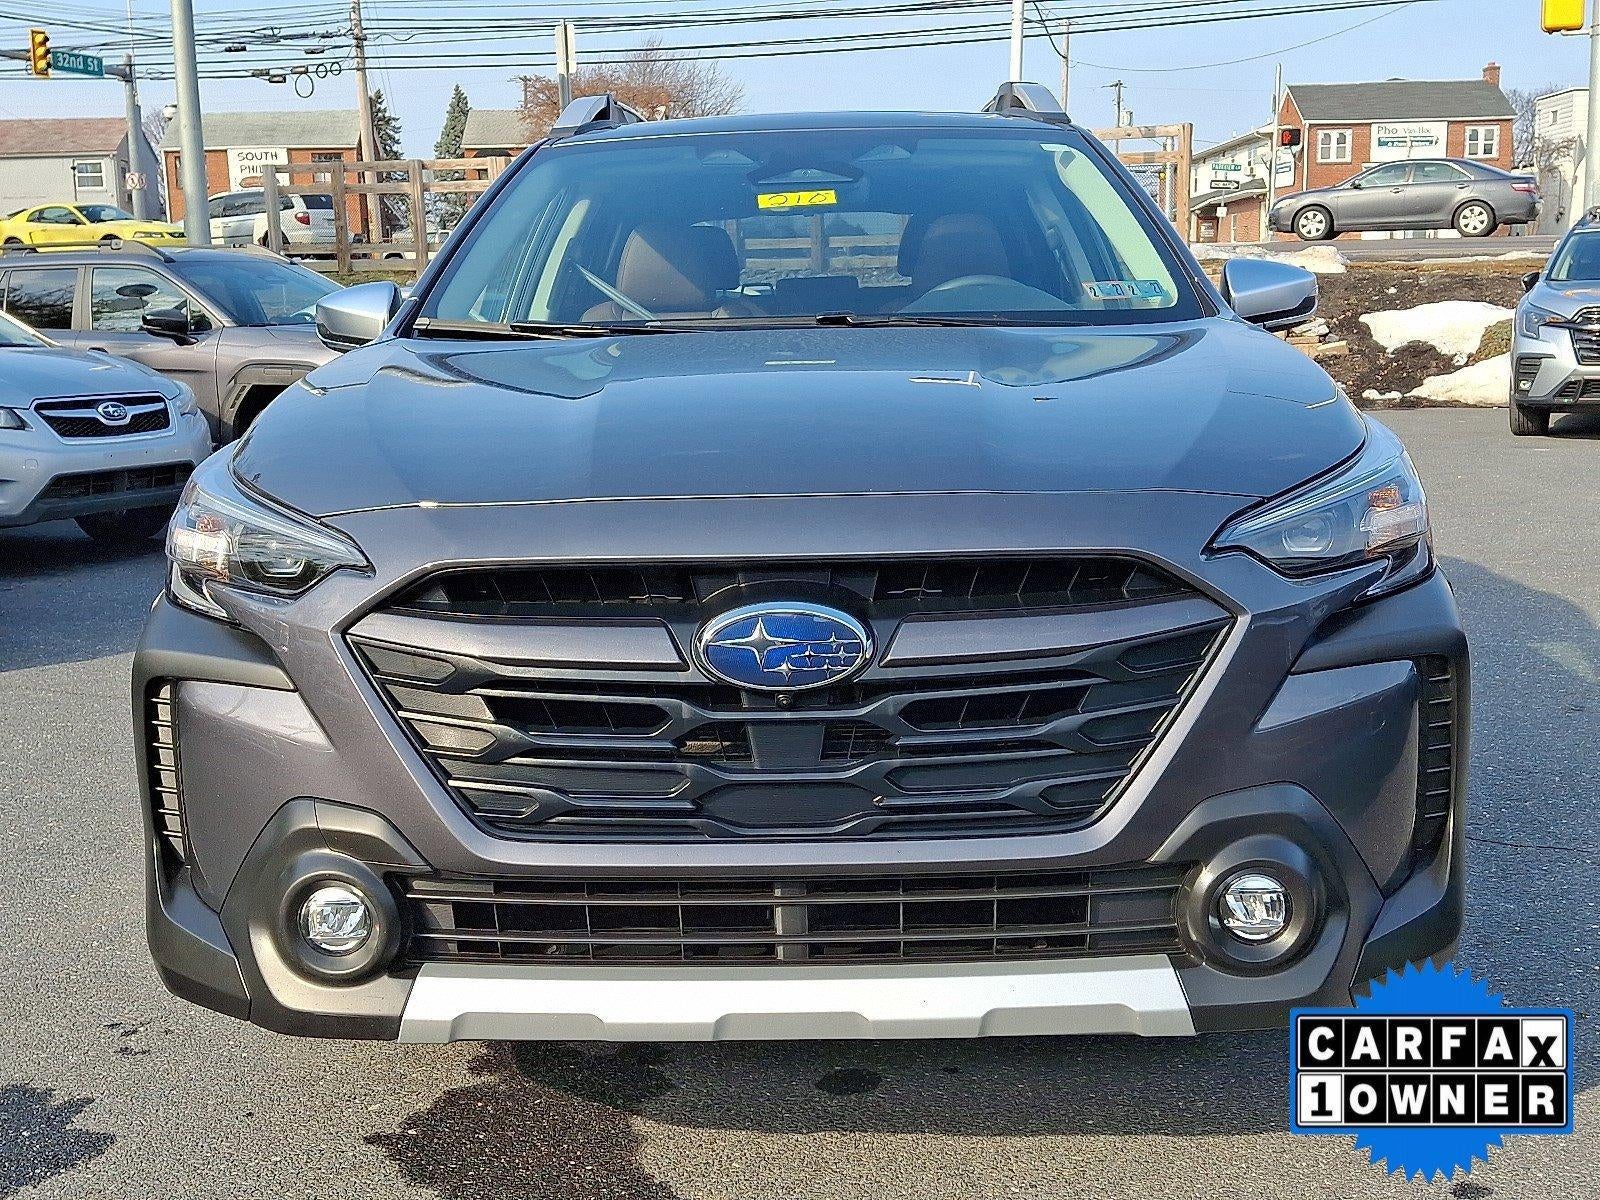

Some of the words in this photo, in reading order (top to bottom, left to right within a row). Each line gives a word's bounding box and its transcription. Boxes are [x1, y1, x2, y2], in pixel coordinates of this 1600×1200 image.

[56, 53, 83, 70] 32nd
[87, 57, 99, 72] St
[1377, 125, 1398, 135] Pho
[237, 151, 278, 162] SOUTH
[240, 164, 264, 174] PHIL
